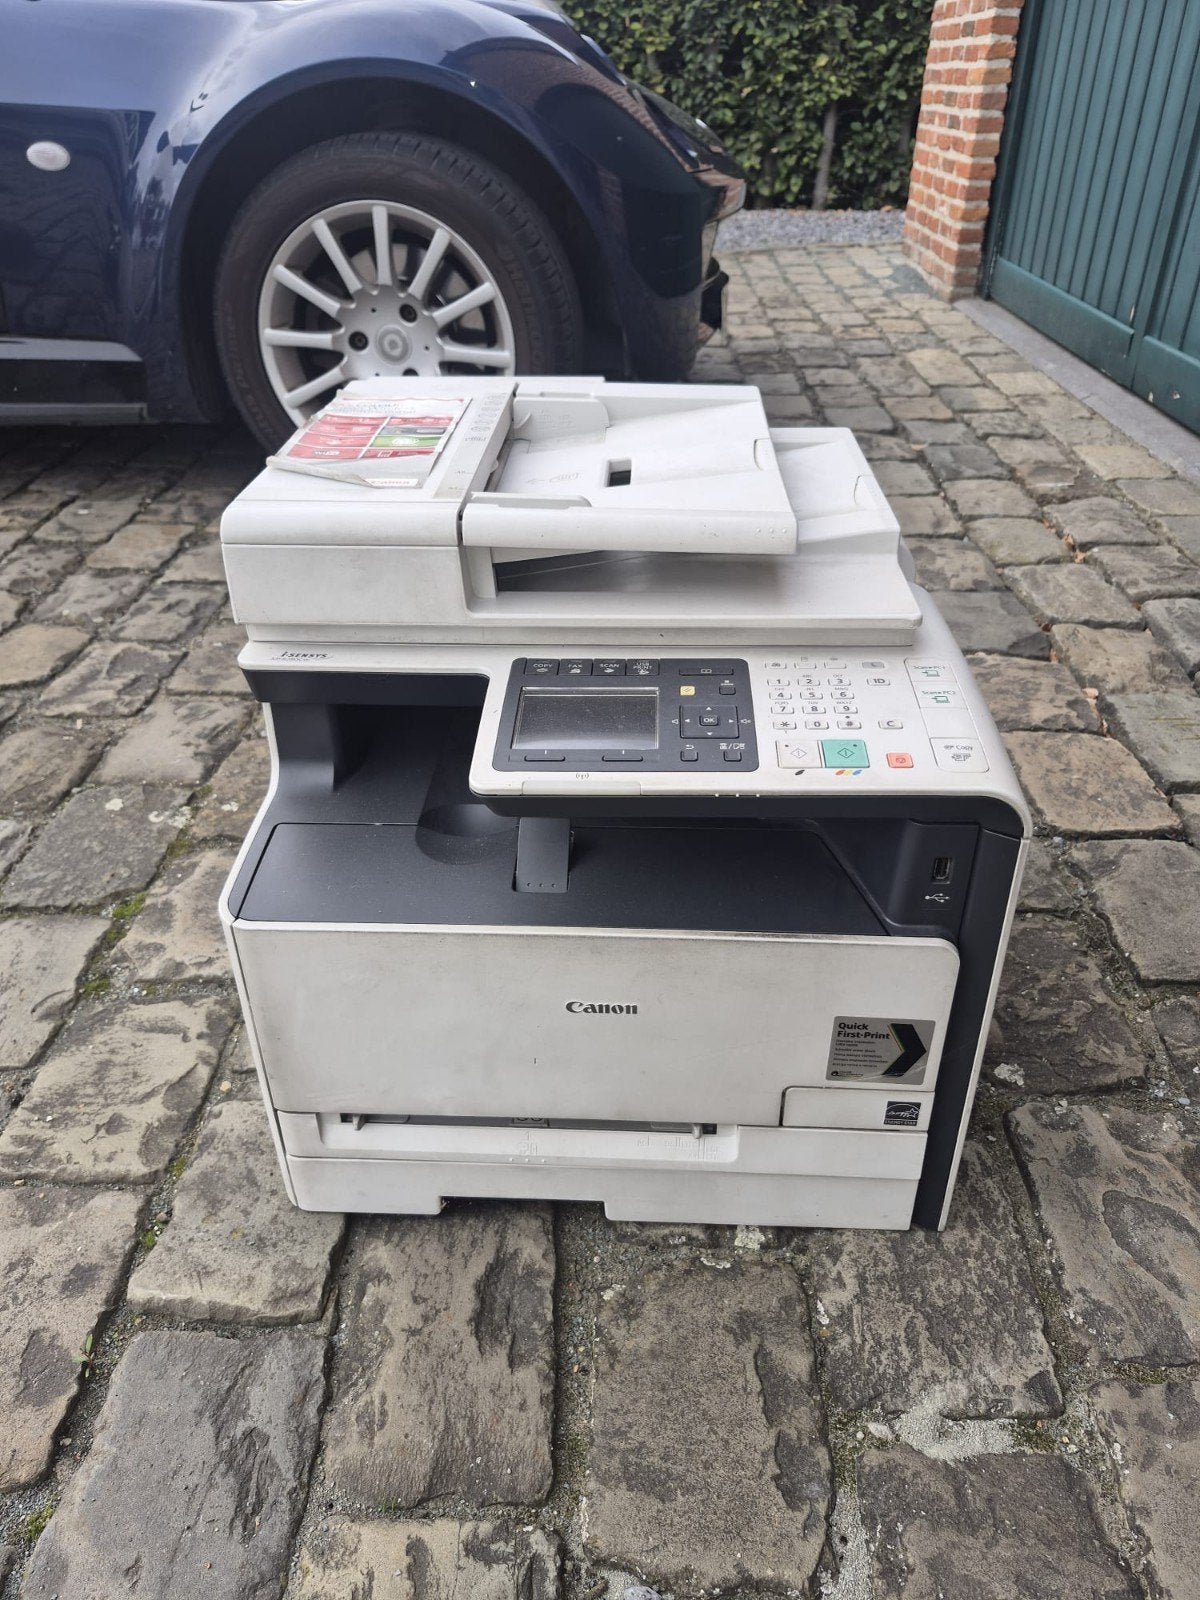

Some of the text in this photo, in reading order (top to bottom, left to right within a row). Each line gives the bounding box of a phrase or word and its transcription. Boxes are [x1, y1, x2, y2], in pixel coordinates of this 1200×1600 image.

[565, 1001, 638, 1015] Canon
[838, 1022, 869, 1030] Quick
[837, 1031, 890, 1039] First-Print
